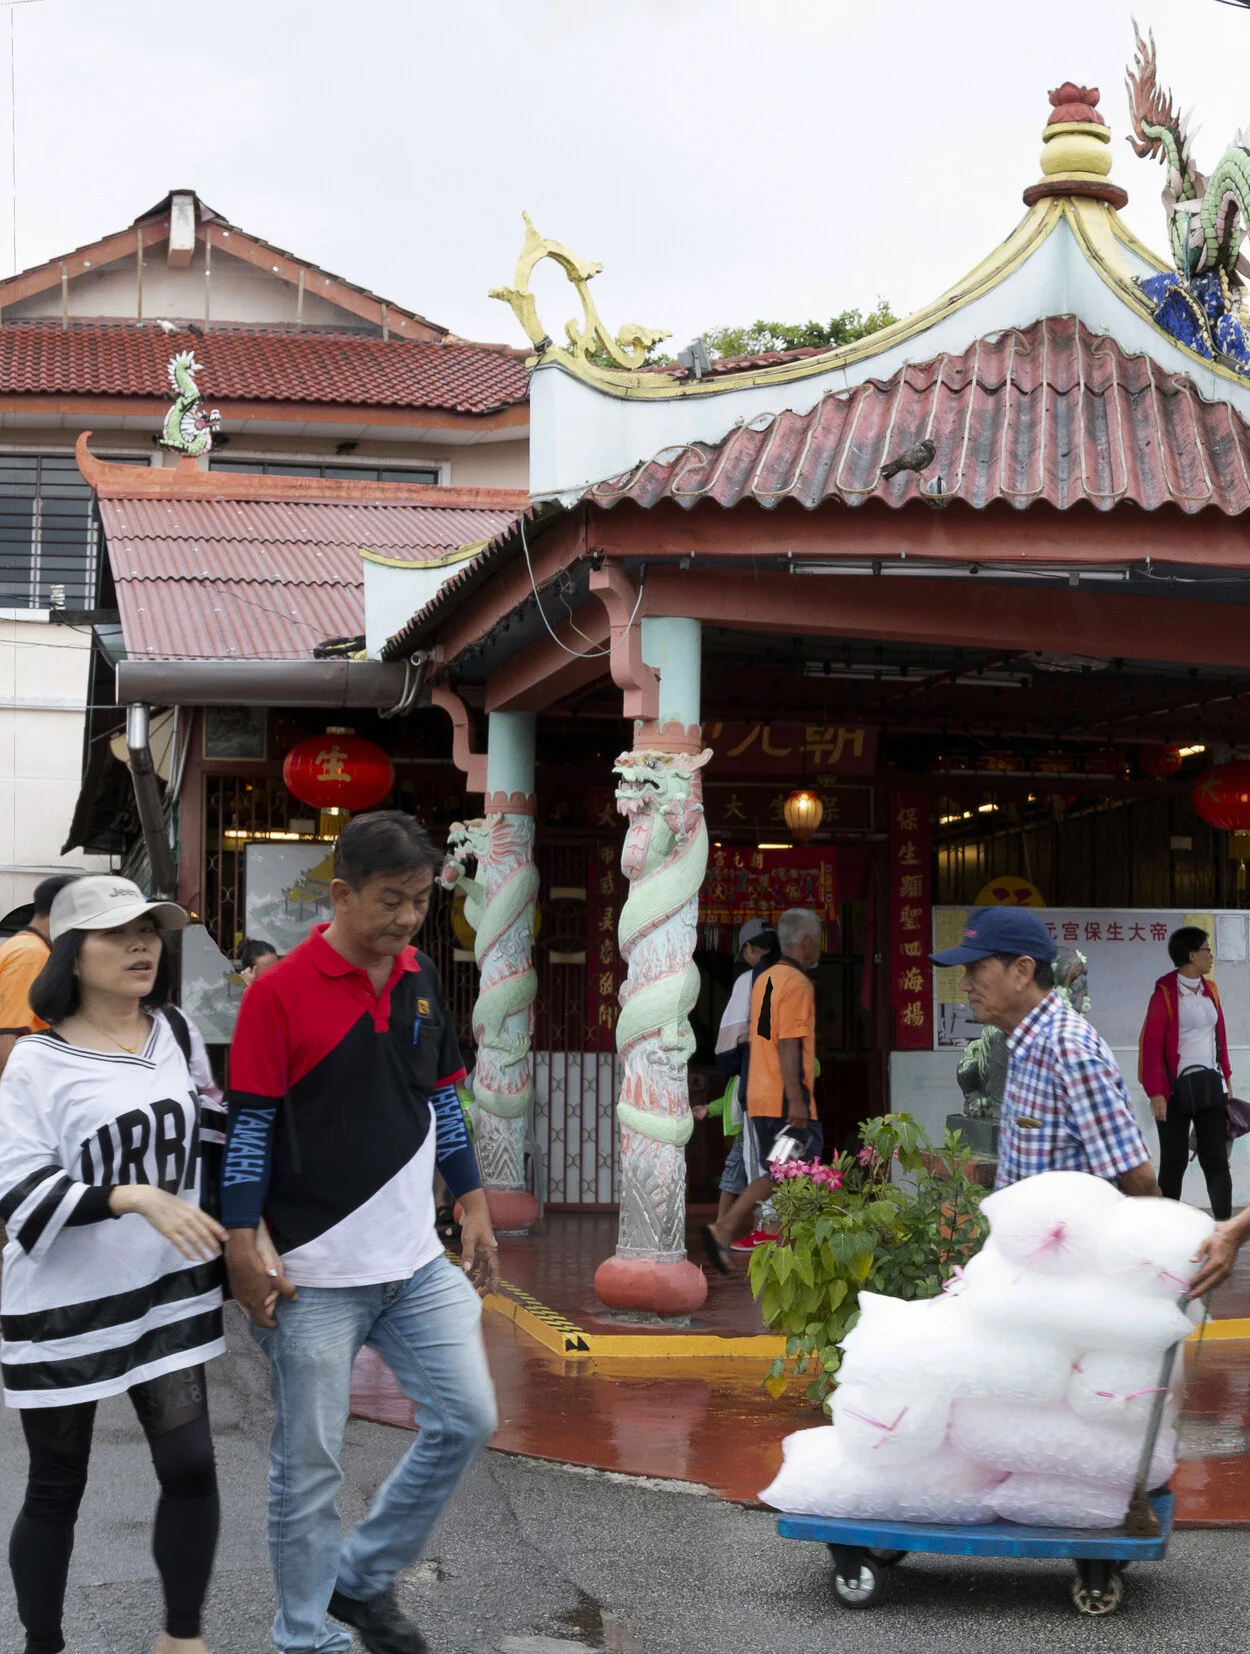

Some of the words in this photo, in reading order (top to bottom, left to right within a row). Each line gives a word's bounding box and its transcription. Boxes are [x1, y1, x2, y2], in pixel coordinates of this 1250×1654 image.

[316, 745, 352, 782] 生
[1198, 771, 1223, 803] 大
[223, 1107, 276, 1188] YAMAHA
